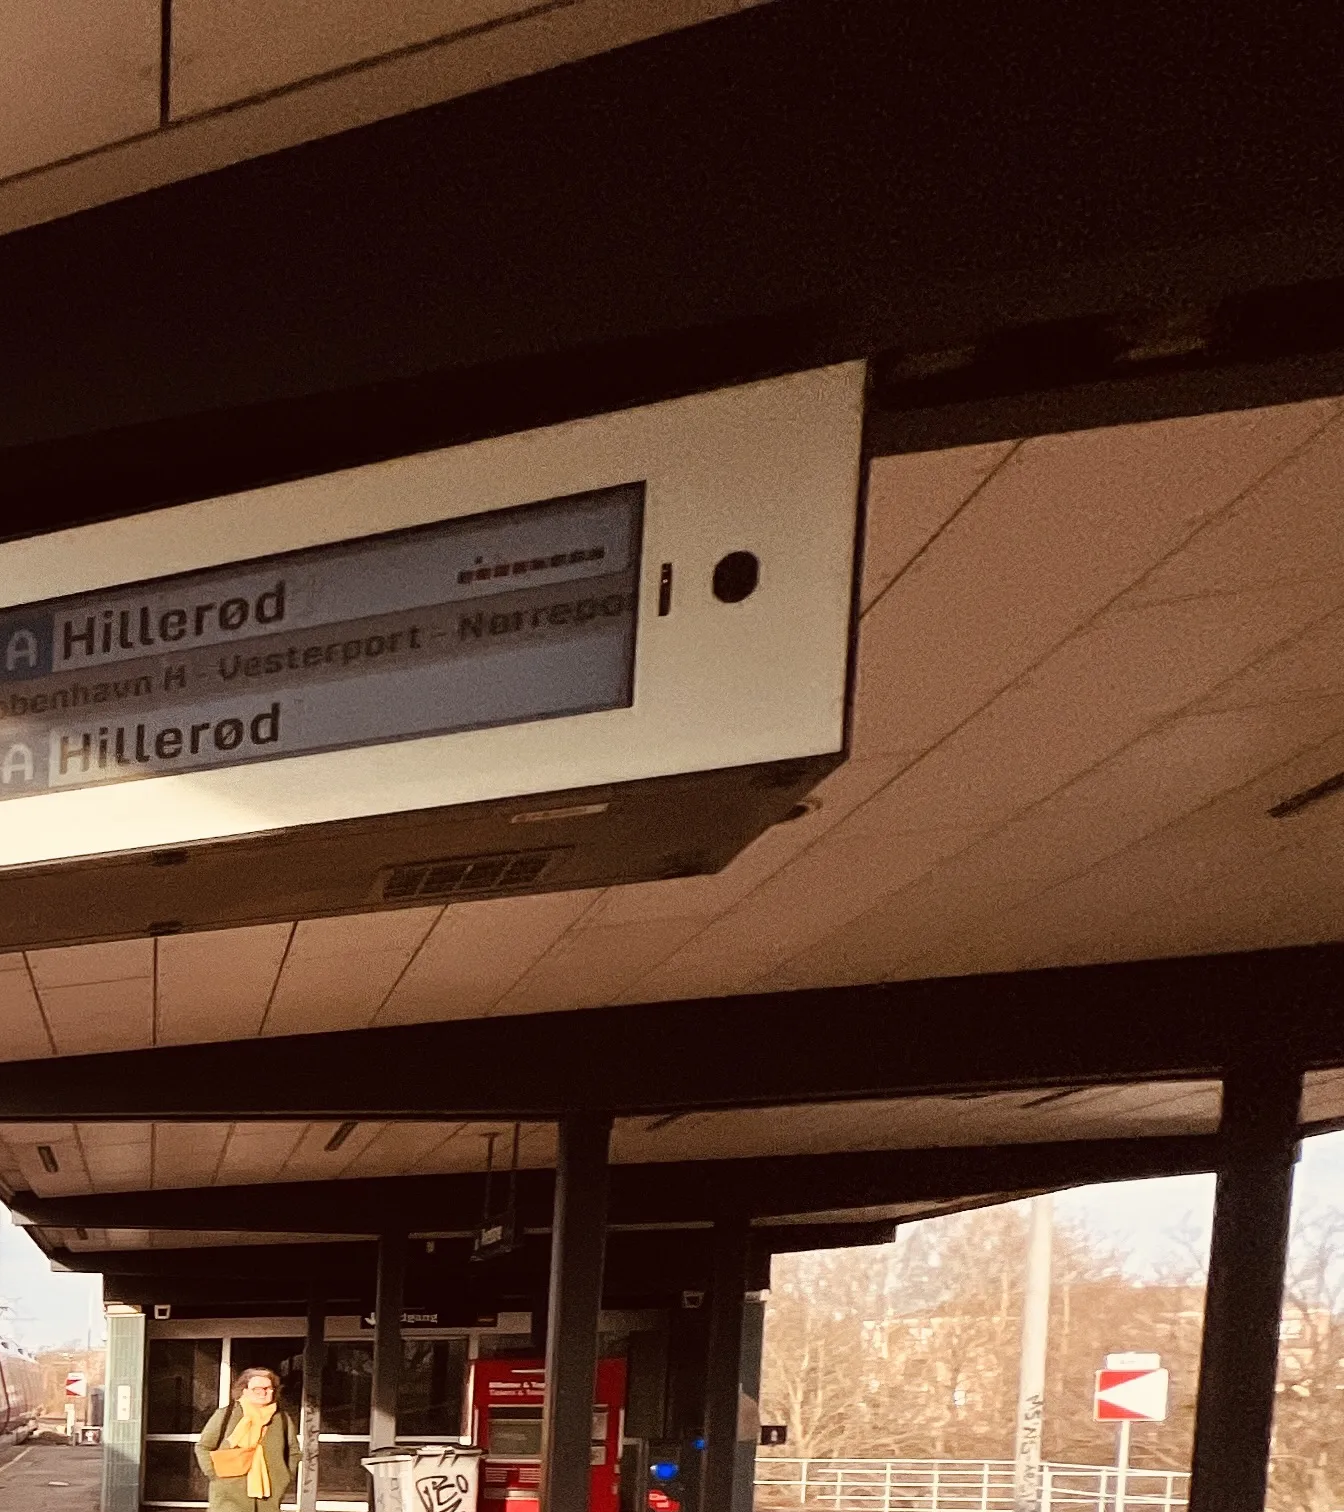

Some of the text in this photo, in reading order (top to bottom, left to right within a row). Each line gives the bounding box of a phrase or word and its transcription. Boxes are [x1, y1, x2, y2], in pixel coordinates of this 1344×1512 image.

[5, 628, 38, 672] A
[62, 579, 286, 661] Hillerød
[164, 663, 187, 692] H
[218, 626, 421, 681] Vesterport
[1, 742, 34, 784] A
[58, 702, 282, 776] Hillerød
[400, 1312, 438, 1324] dgang
